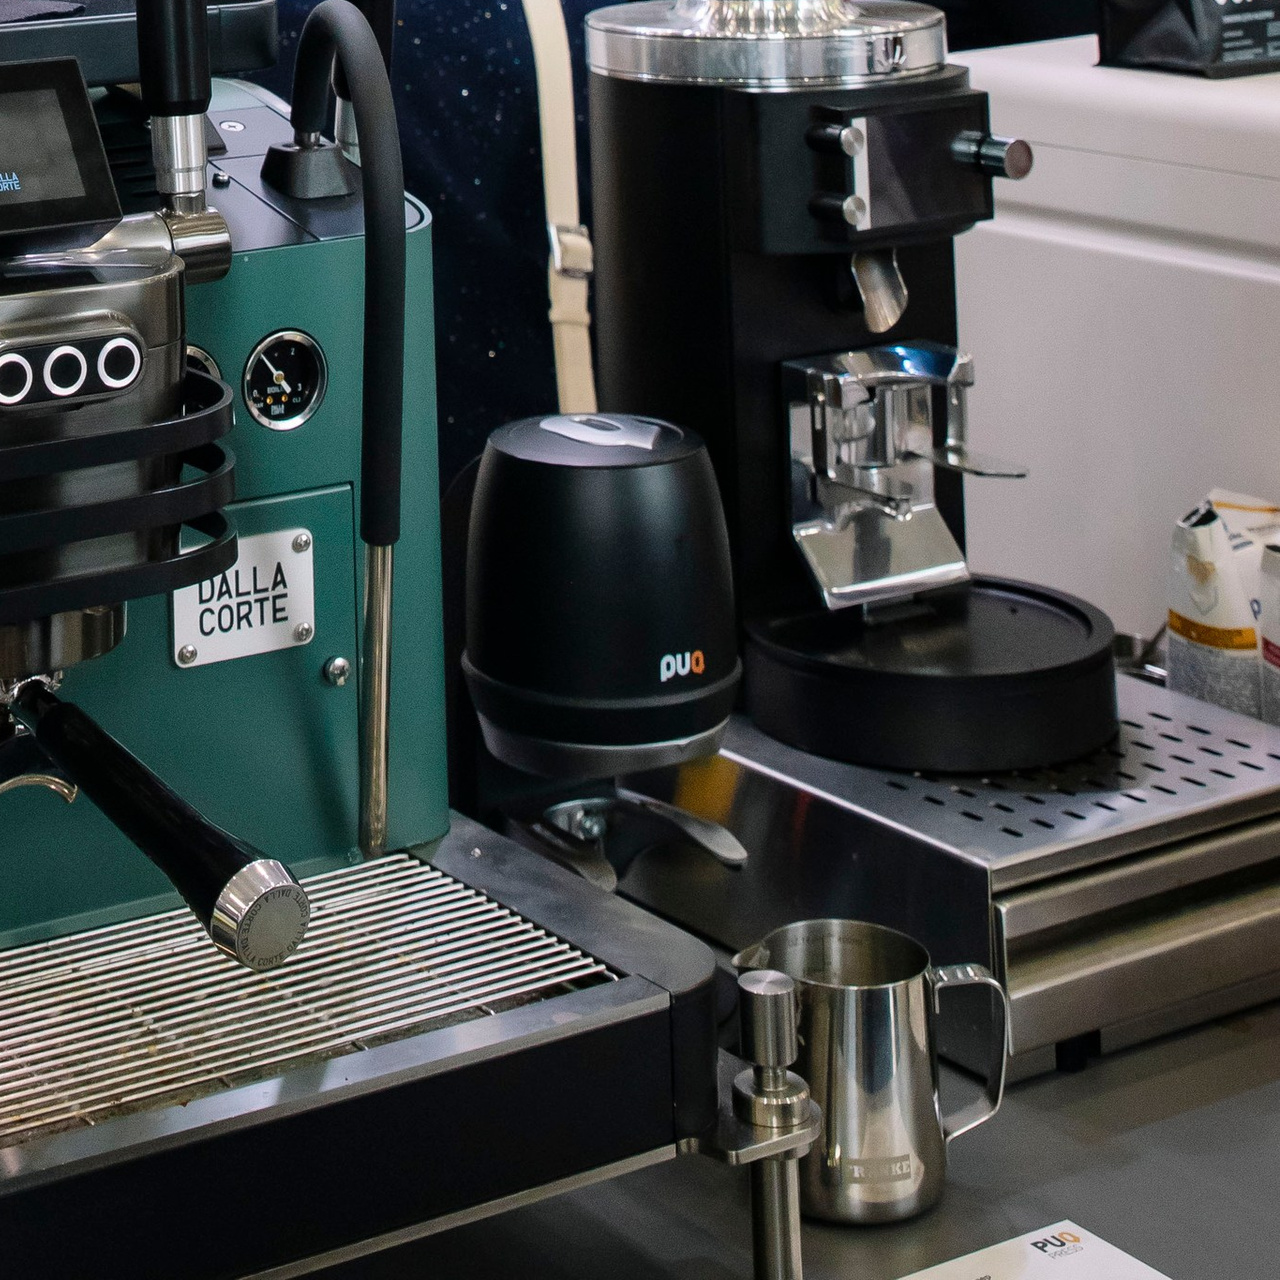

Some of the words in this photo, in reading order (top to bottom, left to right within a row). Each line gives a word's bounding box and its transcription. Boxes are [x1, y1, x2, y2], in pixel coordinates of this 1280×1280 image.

[198, 561, 288, 605] DALLA
[199, 592, 289, 637] CORTE
[1048, 1244, 1084, 1259] PRESS
